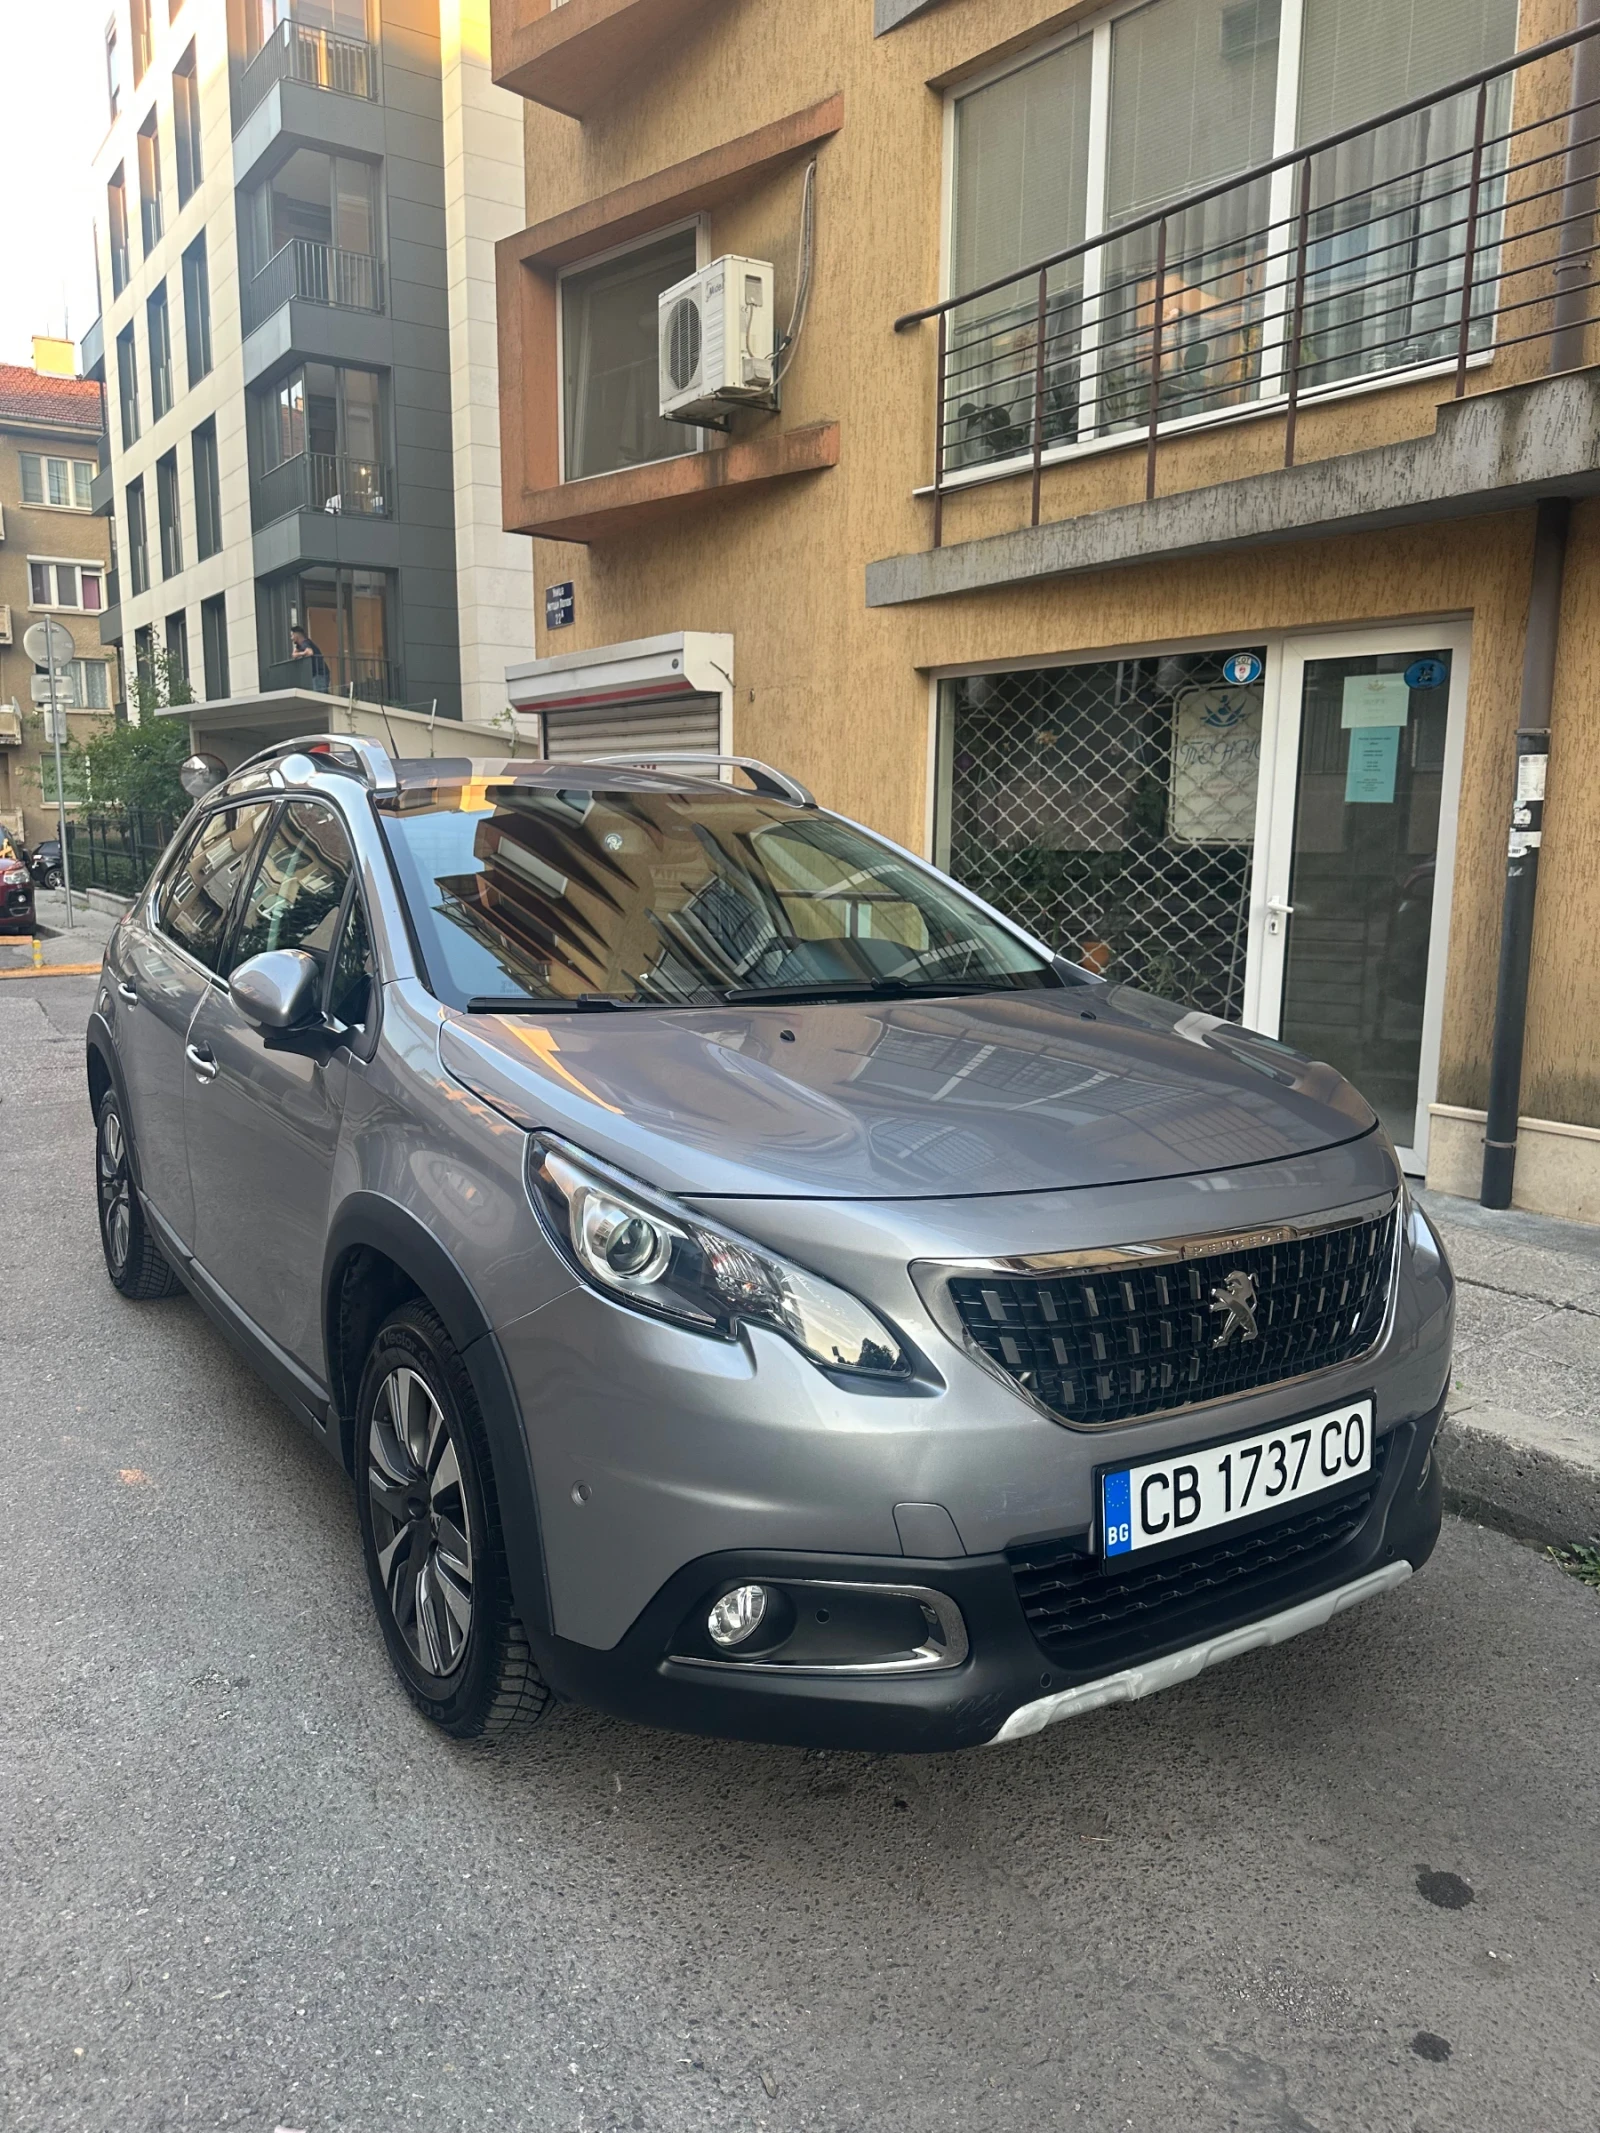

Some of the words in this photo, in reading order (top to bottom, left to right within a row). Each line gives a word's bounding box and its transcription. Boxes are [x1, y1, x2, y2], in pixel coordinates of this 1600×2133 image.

[1193, 1231, 1283, 1256] PEUGEOT
[383, 1331, 417, 1353] Vector
[1140, 1464, 1201, 1535] CB
[1218, 1429, 1311, 1513] 1737
[1320, 1413, 1365, 1478] CO
[1108, 1523, 1129, 1546] BG
